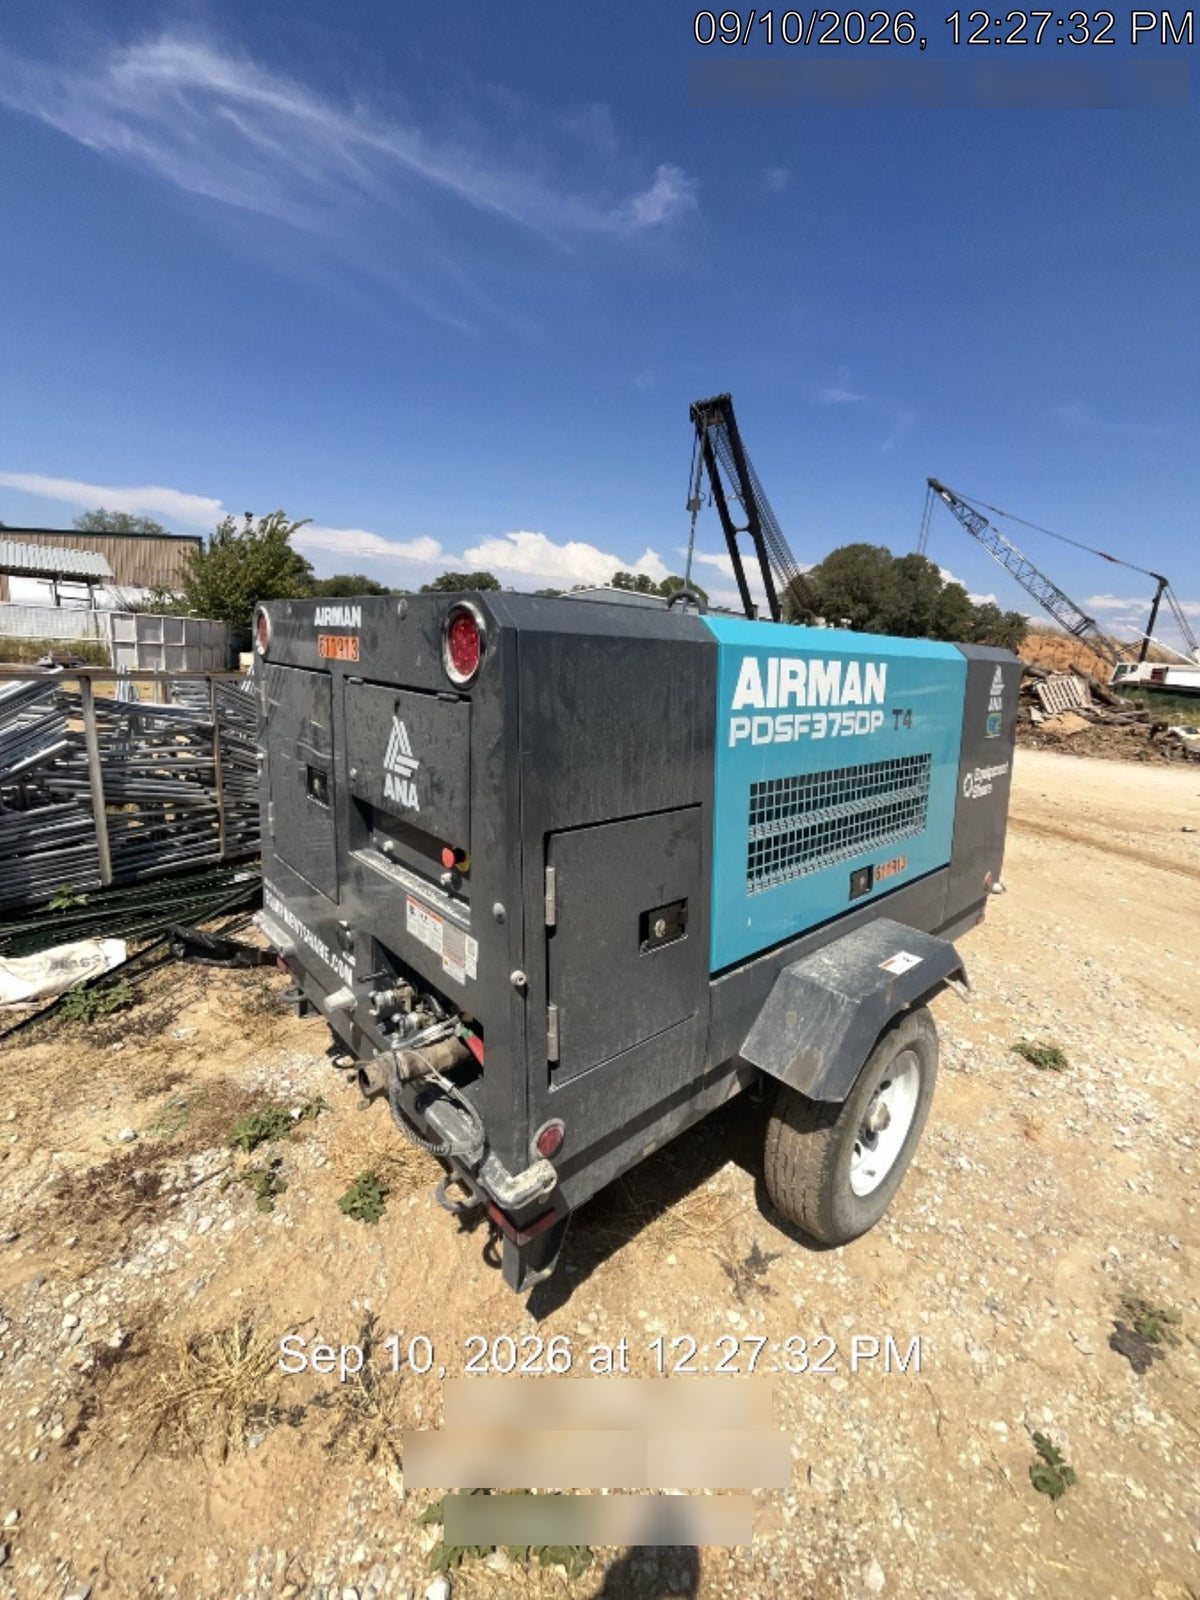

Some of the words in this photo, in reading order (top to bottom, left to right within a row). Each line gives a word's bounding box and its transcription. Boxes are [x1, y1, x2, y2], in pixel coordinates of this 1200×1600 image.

[314, 606, 362, 628] AIRMAN
[731, 656, 888, 711] AIRMAN
[892, 708, 913, 731] T4
[383, 772, 420, 812] ANA
